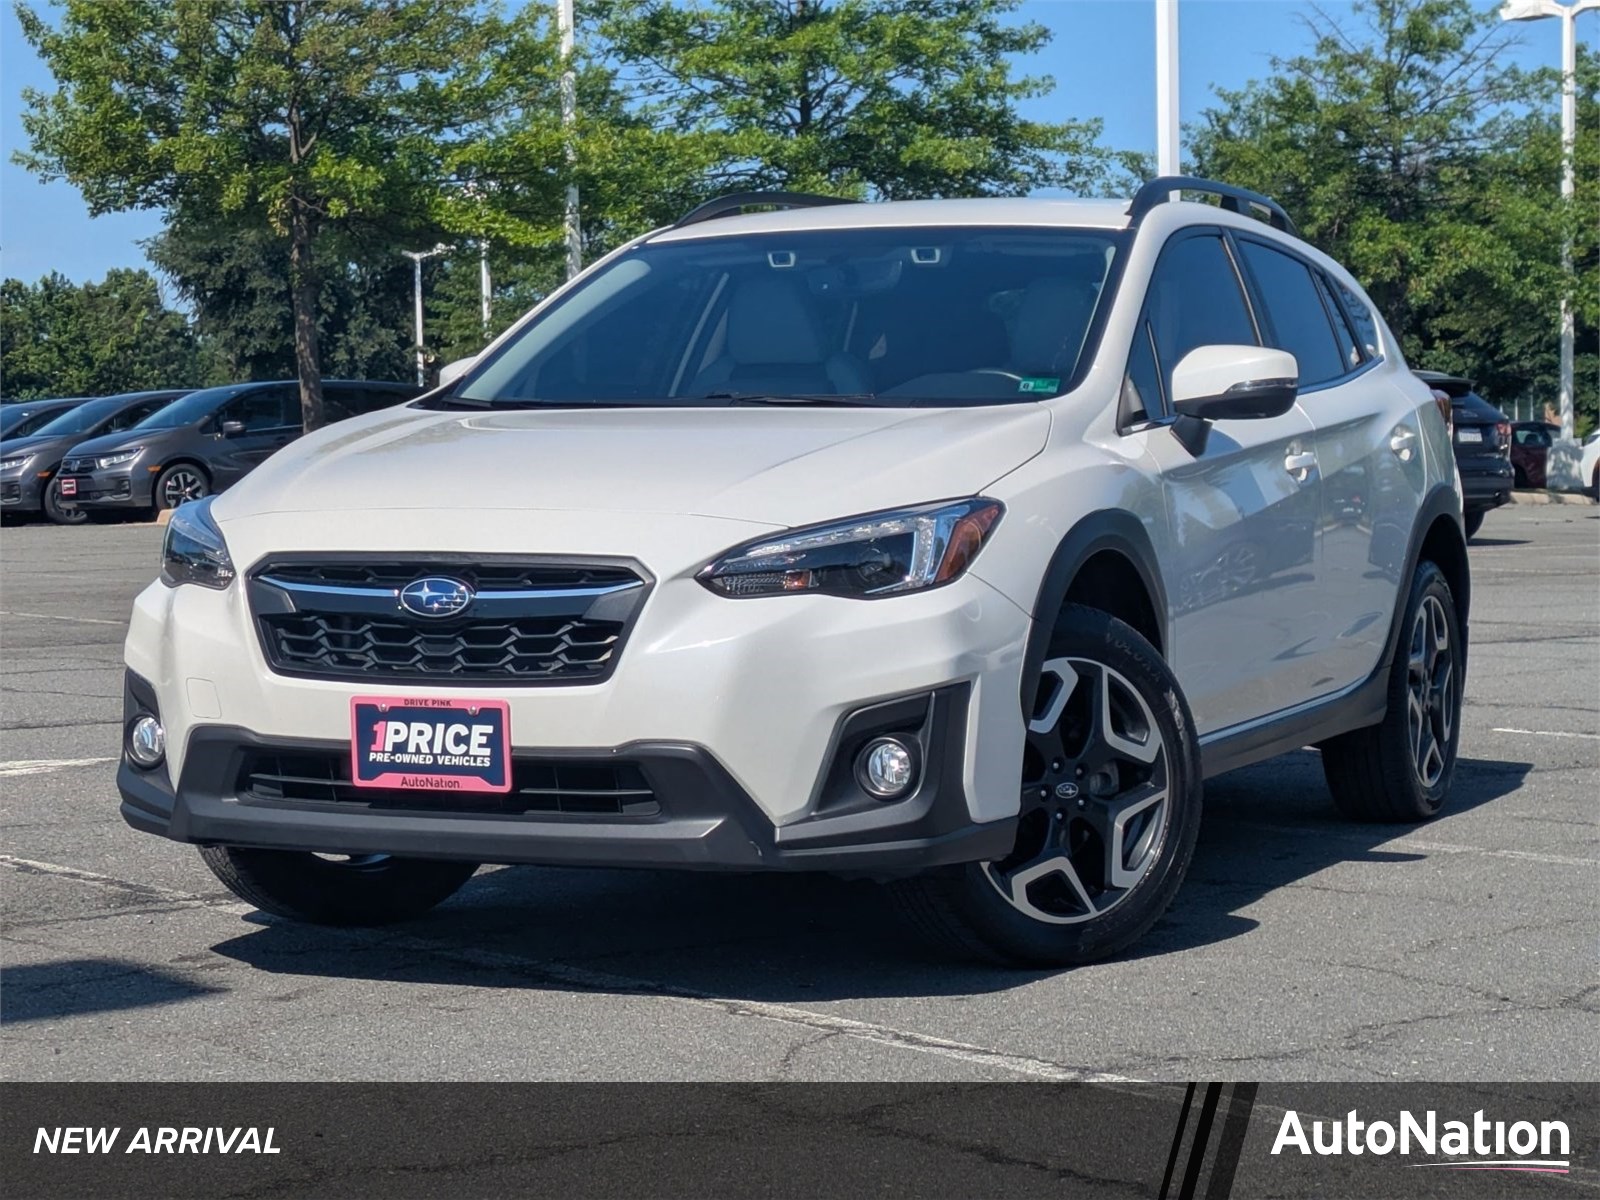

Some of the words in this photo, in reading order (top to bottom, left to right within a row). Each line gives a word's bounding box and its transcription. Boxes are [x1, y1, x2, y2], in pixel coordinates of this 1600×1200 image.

[404, 698, 429, 706] DRIVE
[432, 699, 452, 707] PINK
[370, 721, 494, 756] 1PRICE
[369, 752, 433, 765] PRE-OWNED
[437, 755, 491, 767] VEHICLES
[401, 776, 460, 789] AutoNation
